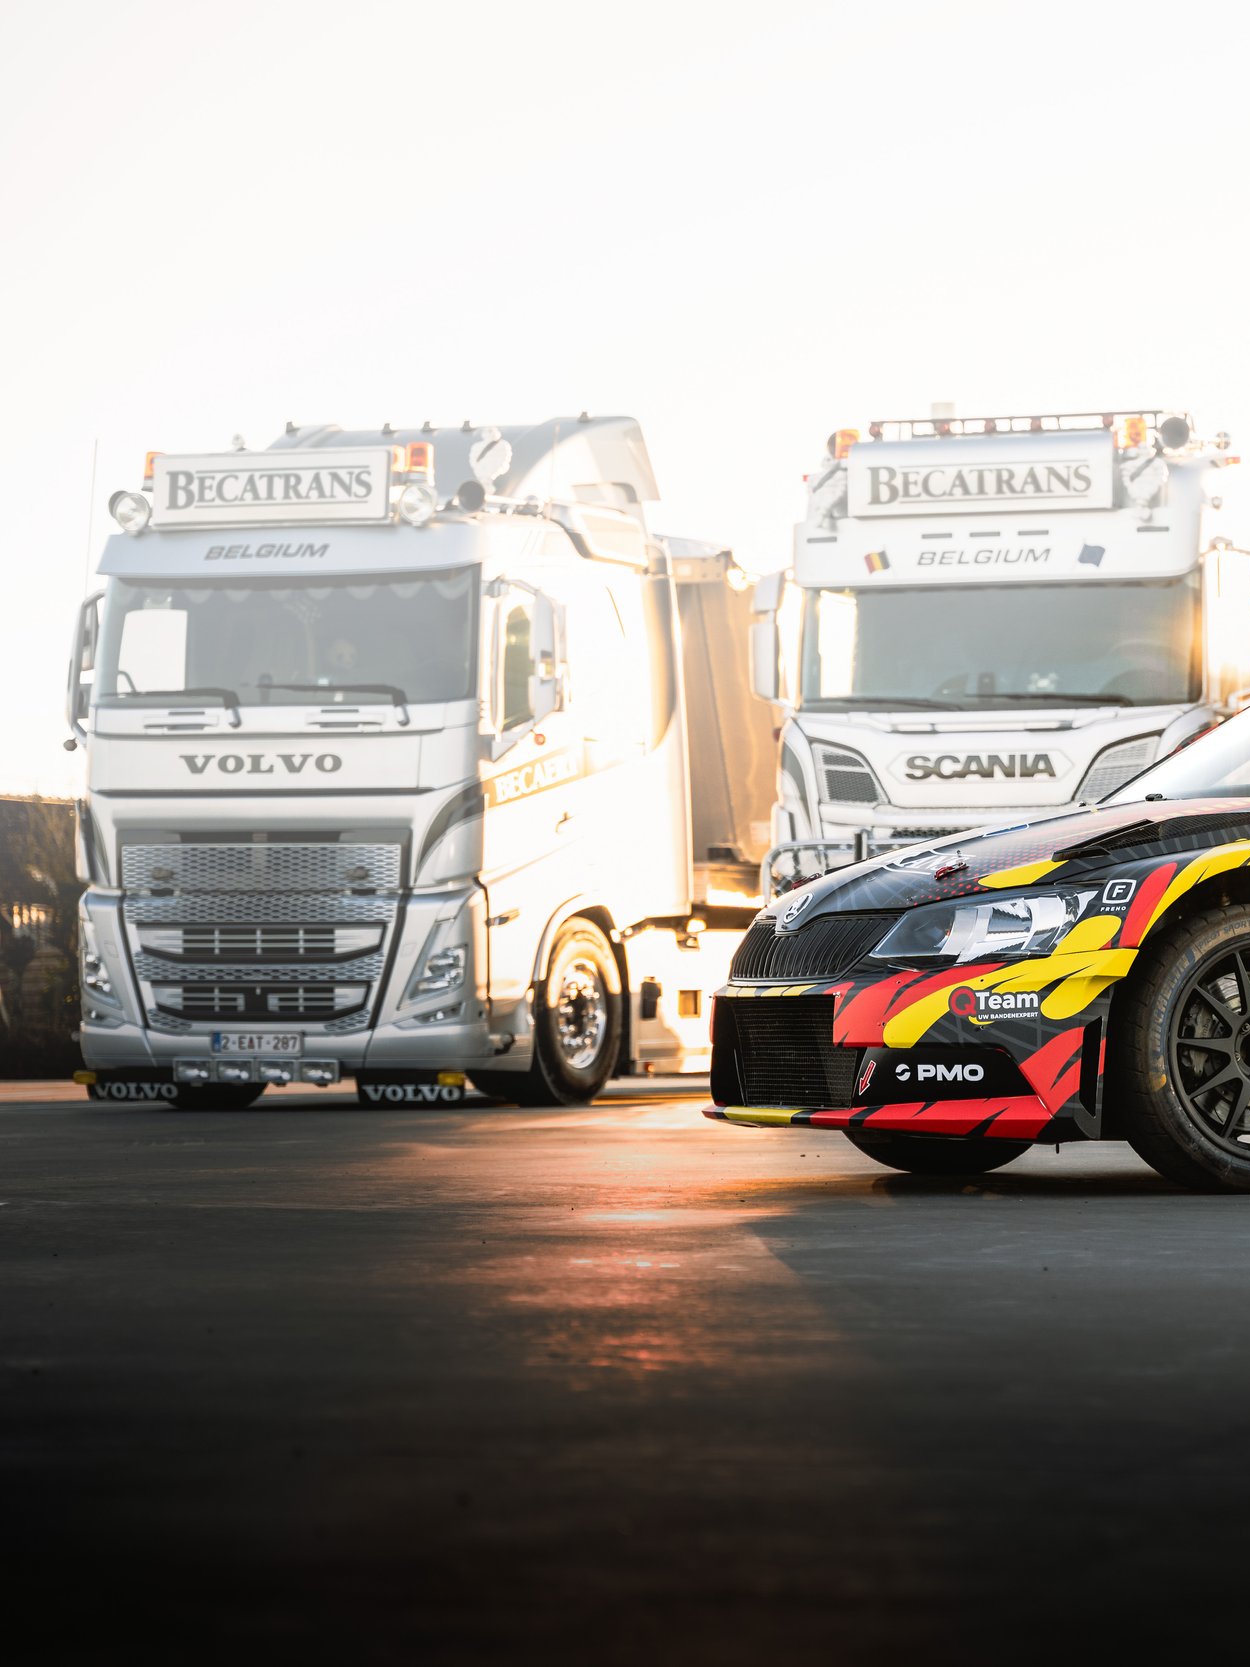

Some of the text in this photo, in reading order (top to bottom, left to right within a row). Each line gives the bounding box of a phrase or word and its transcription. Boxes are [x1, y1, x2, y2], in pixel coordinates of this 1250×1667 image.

[166, 470, 372, 511] BECATRANS
[867, 464, 1092, 506] BECATRANS
[204, 543, 330, 561] BELGIUM
[917, 548, 1051, 566] BELGIUM
[178, 754, 343, 774] VOLVO
[905, 753, 1056, 780] SCANIA
[949, 988, 1039, 1016] QTeam
[990, 1011, 1039, 1019] BANDENEXPERT
[917, 1064, 984, 1081] PMO
[96, 1081, 178, 1099] VOLVO
[361, 1084, 460, 1102] VOLVO
